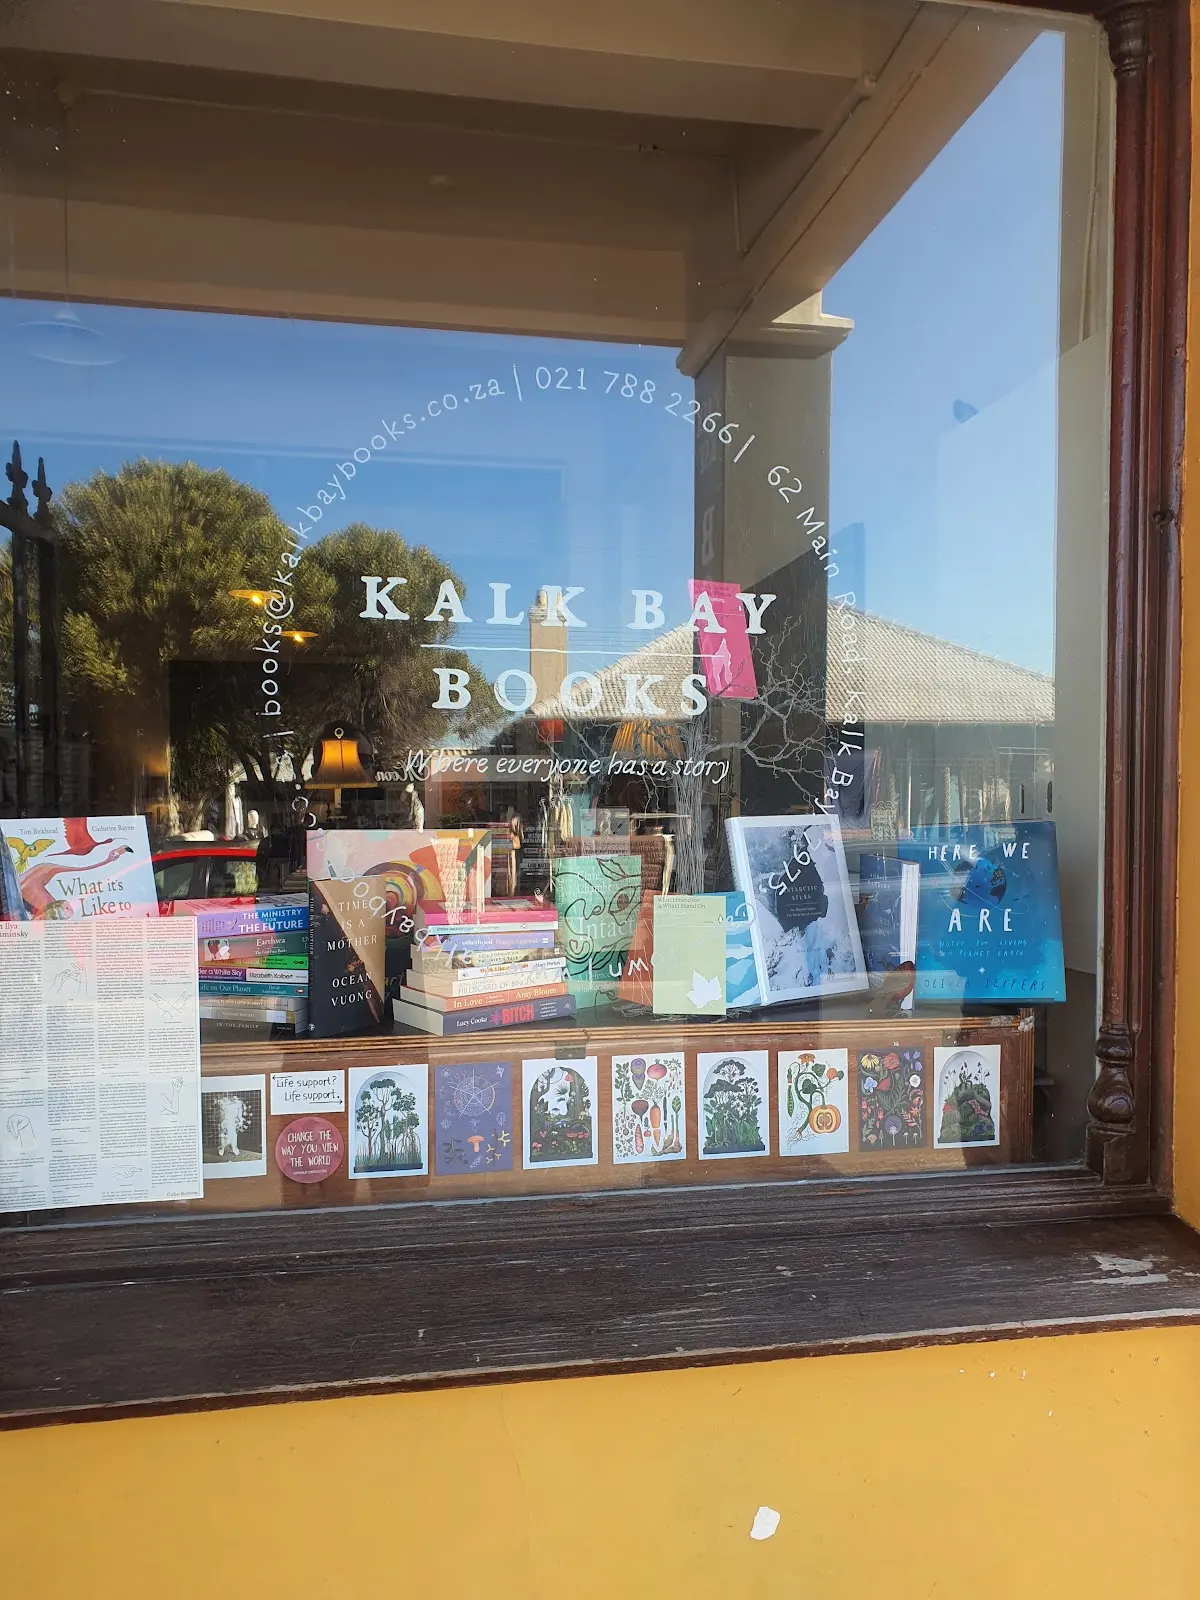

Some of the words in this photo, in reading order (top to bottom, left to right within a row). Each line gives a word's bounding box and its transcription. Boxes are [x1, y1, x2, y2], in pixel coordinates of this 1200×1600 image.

[256, 378, 505, 717] books@kalkbaybooks.co.za
[535, 366, 587, 391] 021
[603, 370, 656, 404] 788
[664, 392, 739, 444] 2266
[767, 465, 802, 503] 62
[796, 507, 840, 578] Main
[837, 690, 867, 757] Kalk
[359, 575, 588, 628] KALK
[627, 589, 777, 634] BAY
[432, 667, 709, 715] BOOKS
[404, 749, 489, 776] Where
[496, 755, 601, 784] everyone
[672, 755, 731, 784] story
[928, 844, 977, 861] HERE
[1003, 842, 1030, 859] WE
[56, 876, 103, 897] What
[107, 878, 124, 892] it's
[577, 882, 620, 894] Chambers
[785, 885, 818, 893] NTARCTIC
[79, 896, 116, 917] Like
[119, 901, 132, 911] to
[338, 899, 368, 912] TIME
[242, 912, 260, 920] THE
[261, 909, 302, 919] MINISTRY
[948, 908, 1013, 932] ARE
[5, 923, 18, 931] Ilya
[238, 924, 260, 933] THE
[262, 919, 303, 931] FUTURE
[358, 919, 365, 928] A
[578, 917, 635, 941] Intact
[0, 930, 29, 938] minsky
[256, 936, 286, 946] Earthsea
[327, 934, 378, 952] MOTHER
[939, 940, 964, 948] NOTES
[1000, 939, 1027, 947] LIVING
[998, 949, 1024, 957] EARTH
[231, 968, 242, 976] Sky
[249, 970, 273, 979] Elizabeth
[274, 971, 293, 979] Kolbert
[332, 971, 372, 989] OCEAN
[458, 983, 498, 995] HILDEGARD
[499, 981, 508, 989] OF
[511, 977, 536, 988] BINGEN
[985, 978, 1046, 991] JEFFERS
[219, 984, 232, 992] Our
[232, 985, 251, 993] Planet
[331, 990, 373, 1007] VUONG
[462, 998, 482, 1007] Love
[515, 988, 532, 1000] Amy
[533, 986, 557, 995] Bloom
[456, 1018, 470, 1027] Lucy
[470, 1017, 488, 1026] Cooke
[502, 1005, 535, 1025] BITCH
[276, 1078, 293, 1088] Life
[297, 1076, 337, 1089] support?
[284, 1091, 300, 1101] Life
[287, 1131, 315, 1143] CHANGE
[319, 1129, 332, 1141] THE
[281, 1145, 296, 1156] WAY
[301, 1143, 318, 1155] YOU
[322, 1142, 339, 1153] VIEW
[290, 1157, 303, 1168] THE
[308, 1156, 331, 1166] WORLD
